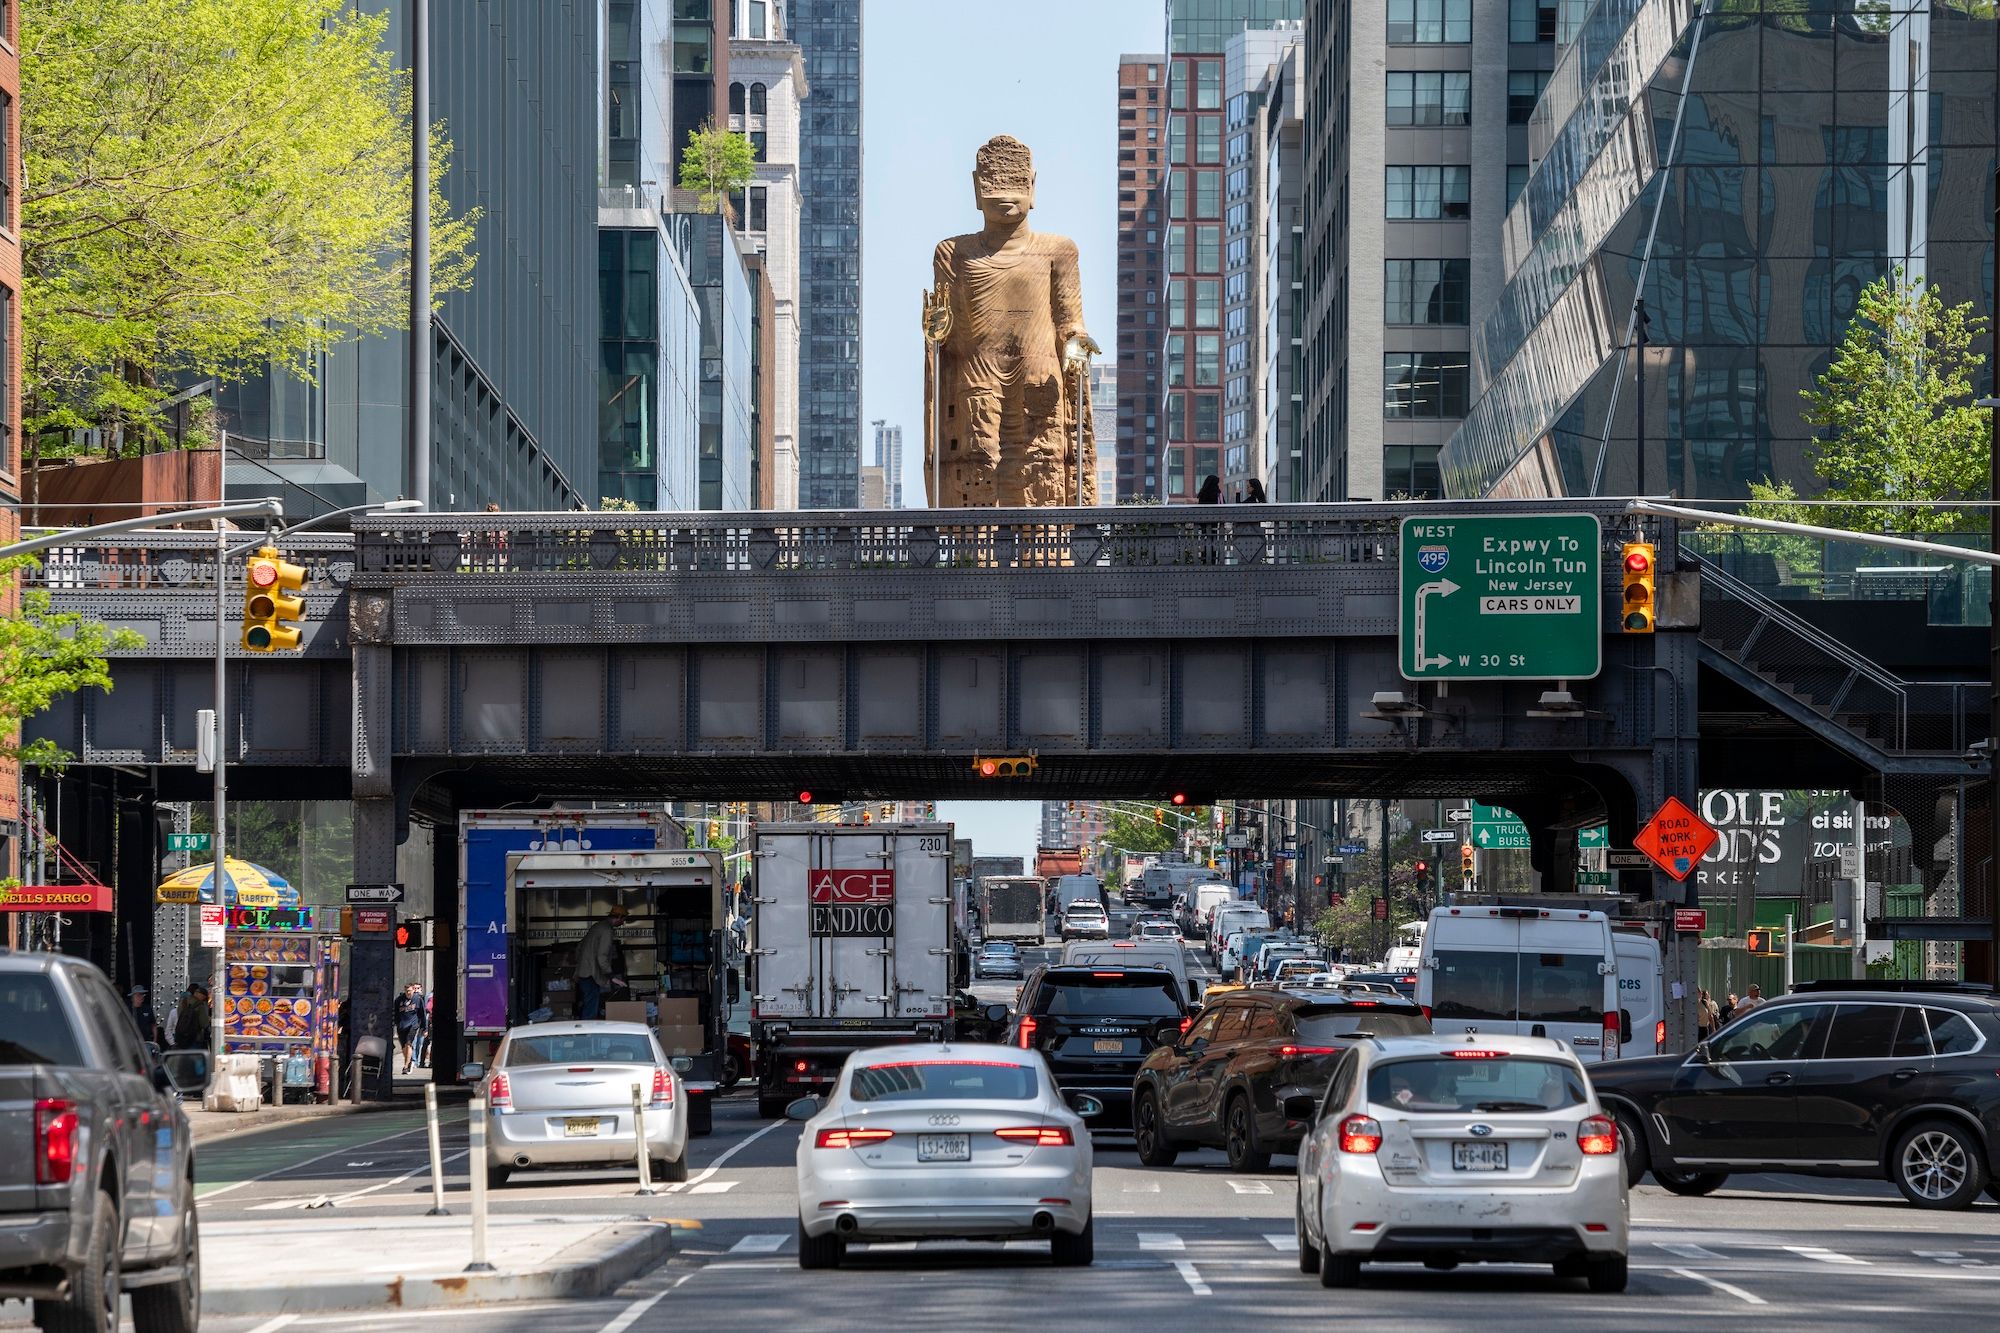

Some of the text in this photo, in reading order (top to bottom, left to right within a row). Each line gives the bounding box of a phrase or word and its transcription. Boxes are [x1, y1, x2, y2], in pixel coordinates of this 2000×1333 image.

[1413, 526, 1455, 538] WEST
[1483, 537, 1579, 555] Expwy To
[1421, 552, 1446, 565] 495
[1475, 558, 1587, 574] Lincoln Tun
[1488, 579, 1573, 593] New Jersey
[1486, 598, 1575, 611] CARS ONLY
[1459, 655, 1525, 666] W 30 St
[1698, 789, 1785, 825] OLE
[1660, 818, 1690, 829] ROAD
[1812, 810, 1829, 829] ci
[174, 836, 182, 848] W
[185, 836, 198, 848] 30
[1661, 832, 1691, 843] WORK
[919, 838, 941, 851] 230
[1659, 845, 1697, 857] AHEAD
[671, 857, 687, 866] 3855
[1580, 873, 1587, 883] W
[1589, 873, 1599, 884] 30
[812, 874, 892, 898] ACE
[46, 893, 92, 903] FARGO
[160, 890, 197, 899] SABRETT
[354, 889, 396, 898] ONE WAY
[811, 907, 893, 933] ENDICO
